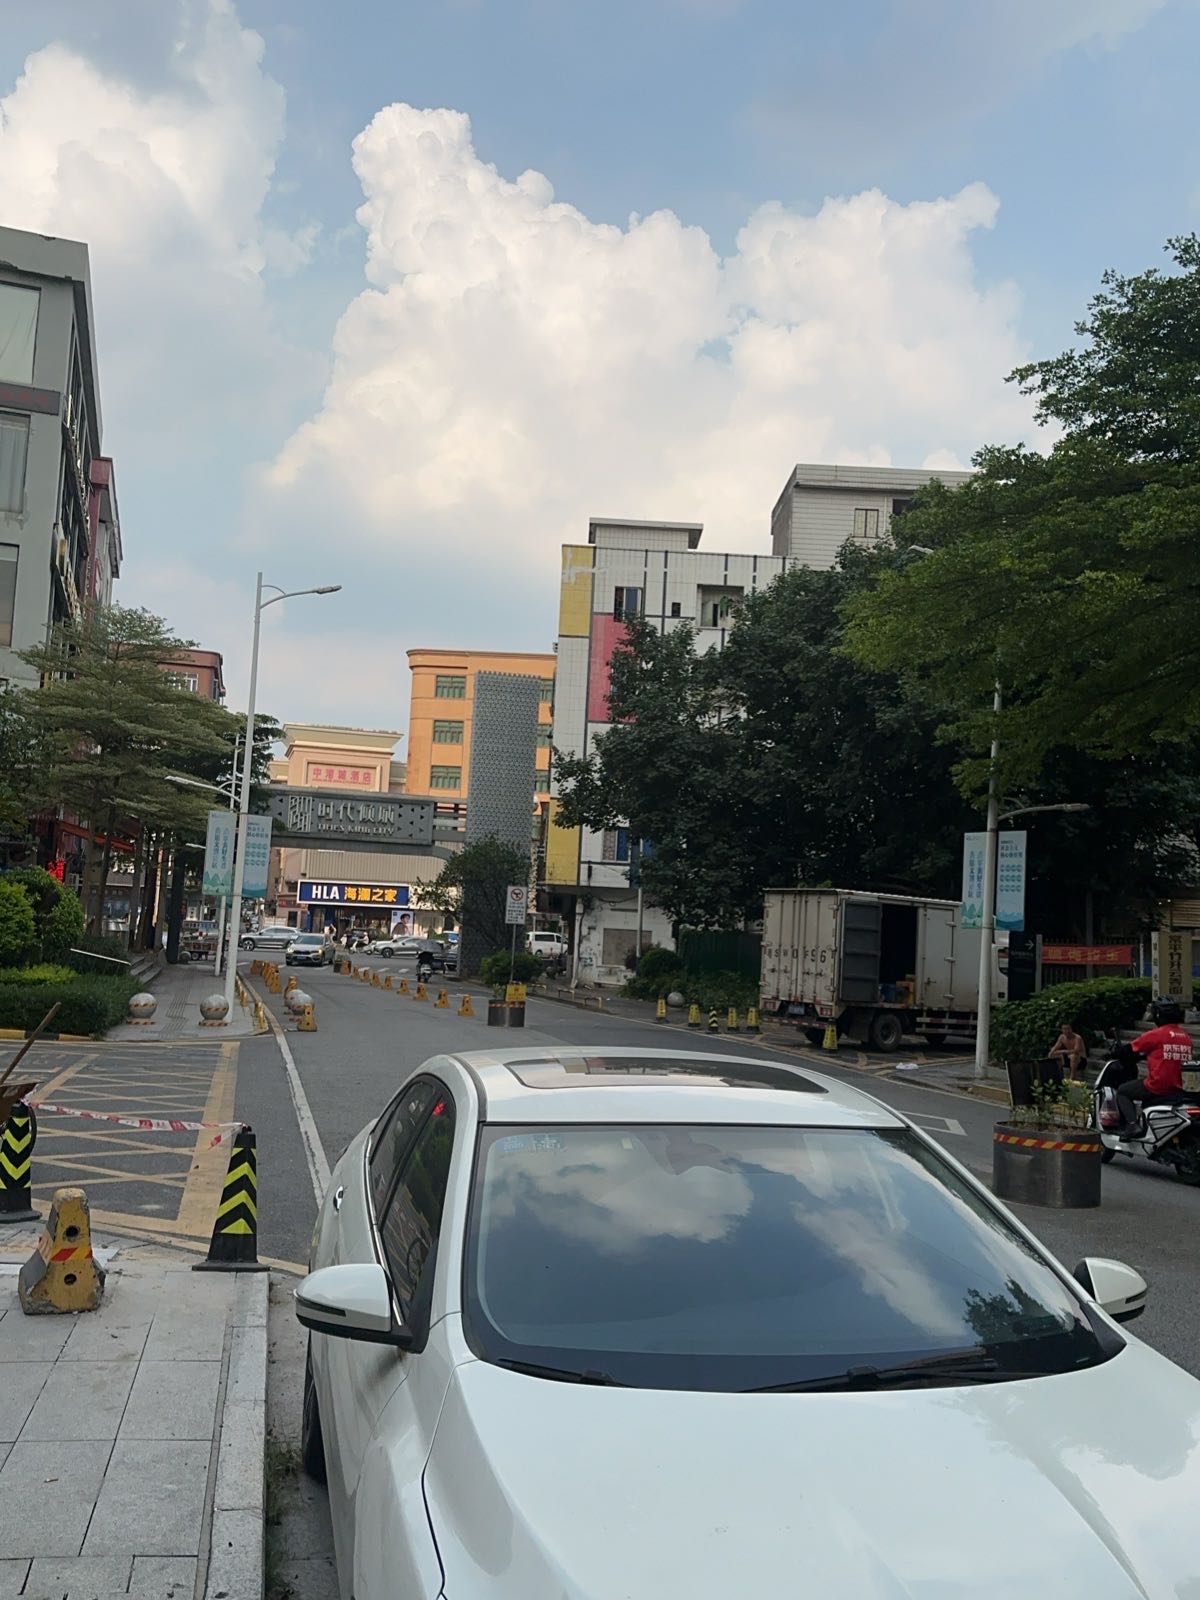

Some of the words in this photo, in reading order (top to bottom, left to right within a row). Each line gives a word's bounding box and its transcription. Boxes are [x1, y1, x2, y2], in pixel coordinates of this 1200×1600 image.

[317, 801, 395, 824] 时代倾城
[312, 885, 340, 900] HLA
[344, 886, 398, 902] 海澜之家
